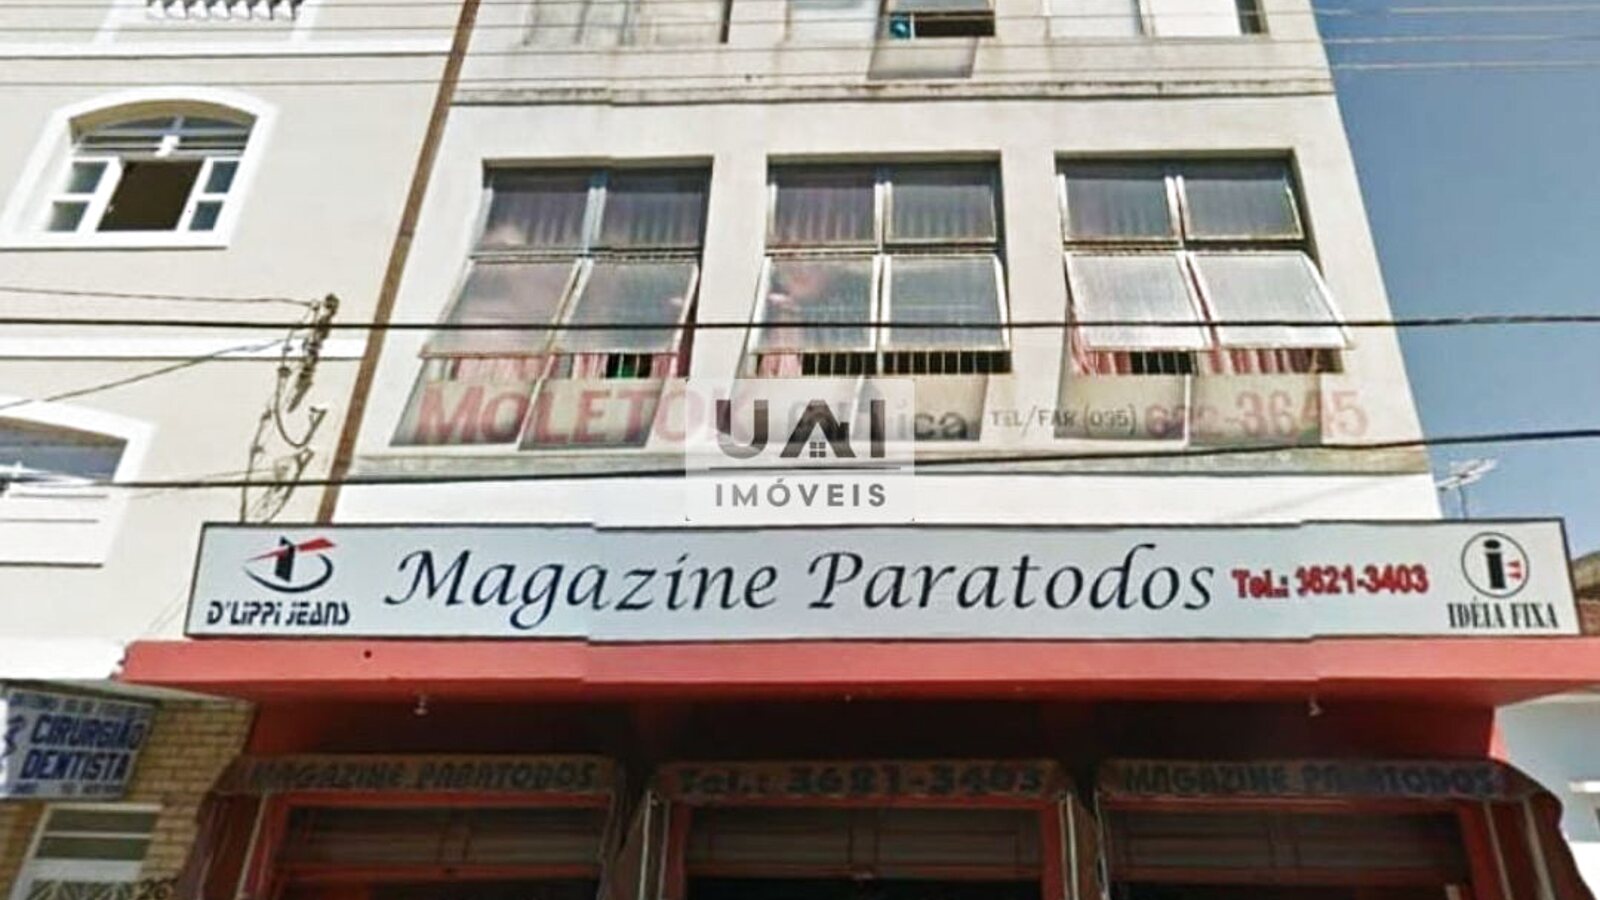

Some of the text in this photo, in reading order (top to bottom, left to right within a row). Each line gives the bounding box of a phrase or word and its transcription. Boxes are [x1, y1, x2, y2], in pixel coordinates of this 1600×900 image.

[384, 543, 1214, 631] Magazine Paratodos
[1232, 569, 1289, 599] Tel.:
[1510, 602, 1559, 628] FIXA
[20, 749, 131, 780] DENTISTA
